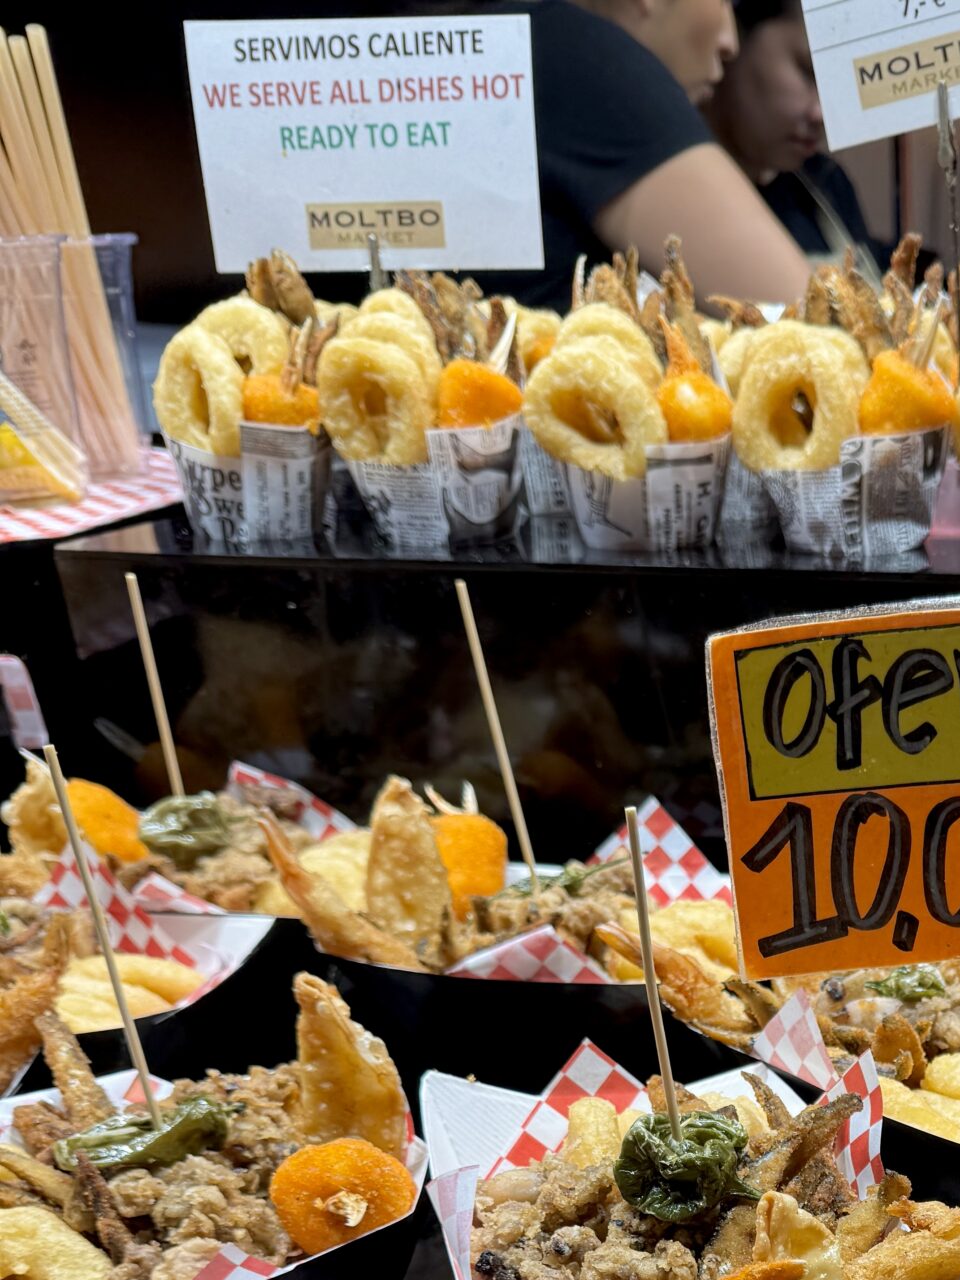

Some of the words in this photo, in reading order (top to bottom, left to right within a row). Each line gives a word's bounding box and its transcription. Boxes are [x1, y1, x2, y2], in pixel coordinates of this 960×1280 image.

[233, 34, 361, 63] SERVIMOS
[367, 29, 484, 58] CALIENTE
[202, 83, 242, 108] WE
[250, 81, 322, 107] SERVE
[329, 79, 371, 104] ALL
[378, 76, 464, 103] DISHES
[472, 74, 525, 100] HOT
[280, 124, 358, 151] READY
[365, 123, 398, 148] TO
[407, 121, 451, 147] EAT
[309, 209, 440, 229] MOLTBO
[338, 231, 415, 244] MAKET
